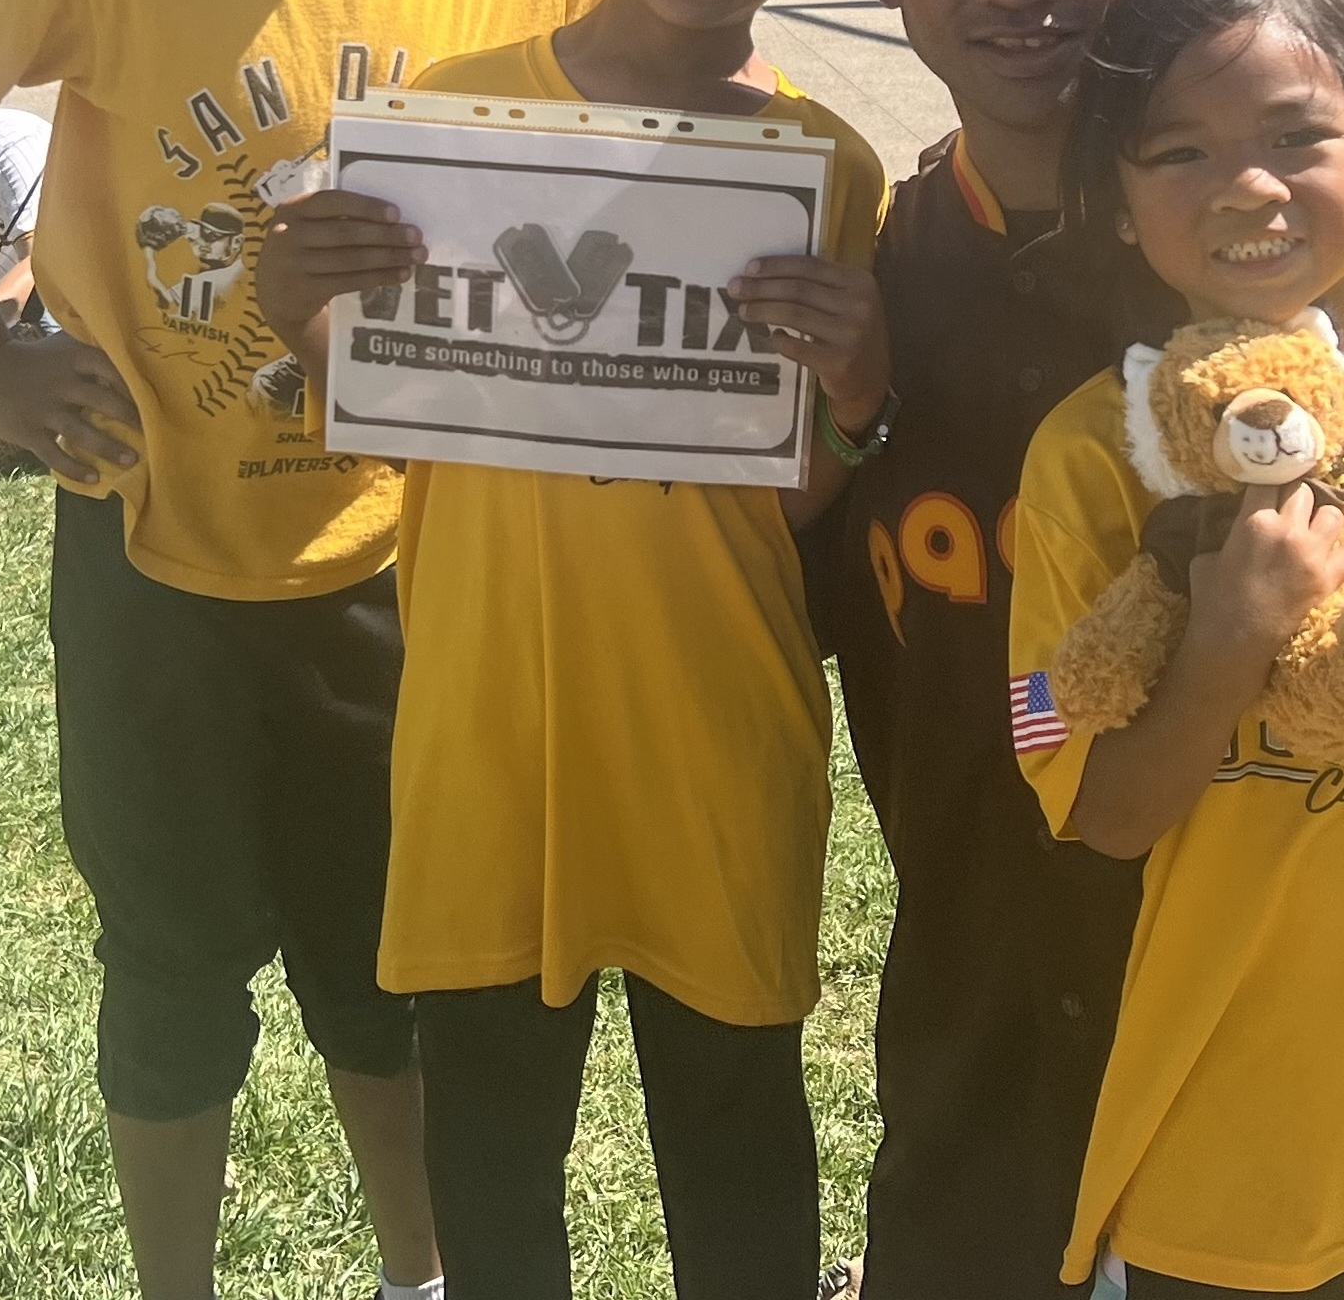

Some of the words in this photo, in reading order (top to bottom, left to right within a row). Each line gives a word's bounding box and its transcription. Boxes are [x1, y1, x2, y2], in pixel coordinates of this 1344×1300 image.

[156, 58, 291, 180] SAN
[180, 276, 213, 322] 11
[359, 263, 506, 333] VET
[624, 272, 776, 354] TIX
[369, 334, 417, 359] Give
[425, 345, 542, 376] something
[551, 358, 573, 376] to
[582, 359, 644, 380] those
[653, 363, 699, 382] who
[708, 367, 761, 386] gave
[246, 456, 334, 478] PLAYERS
